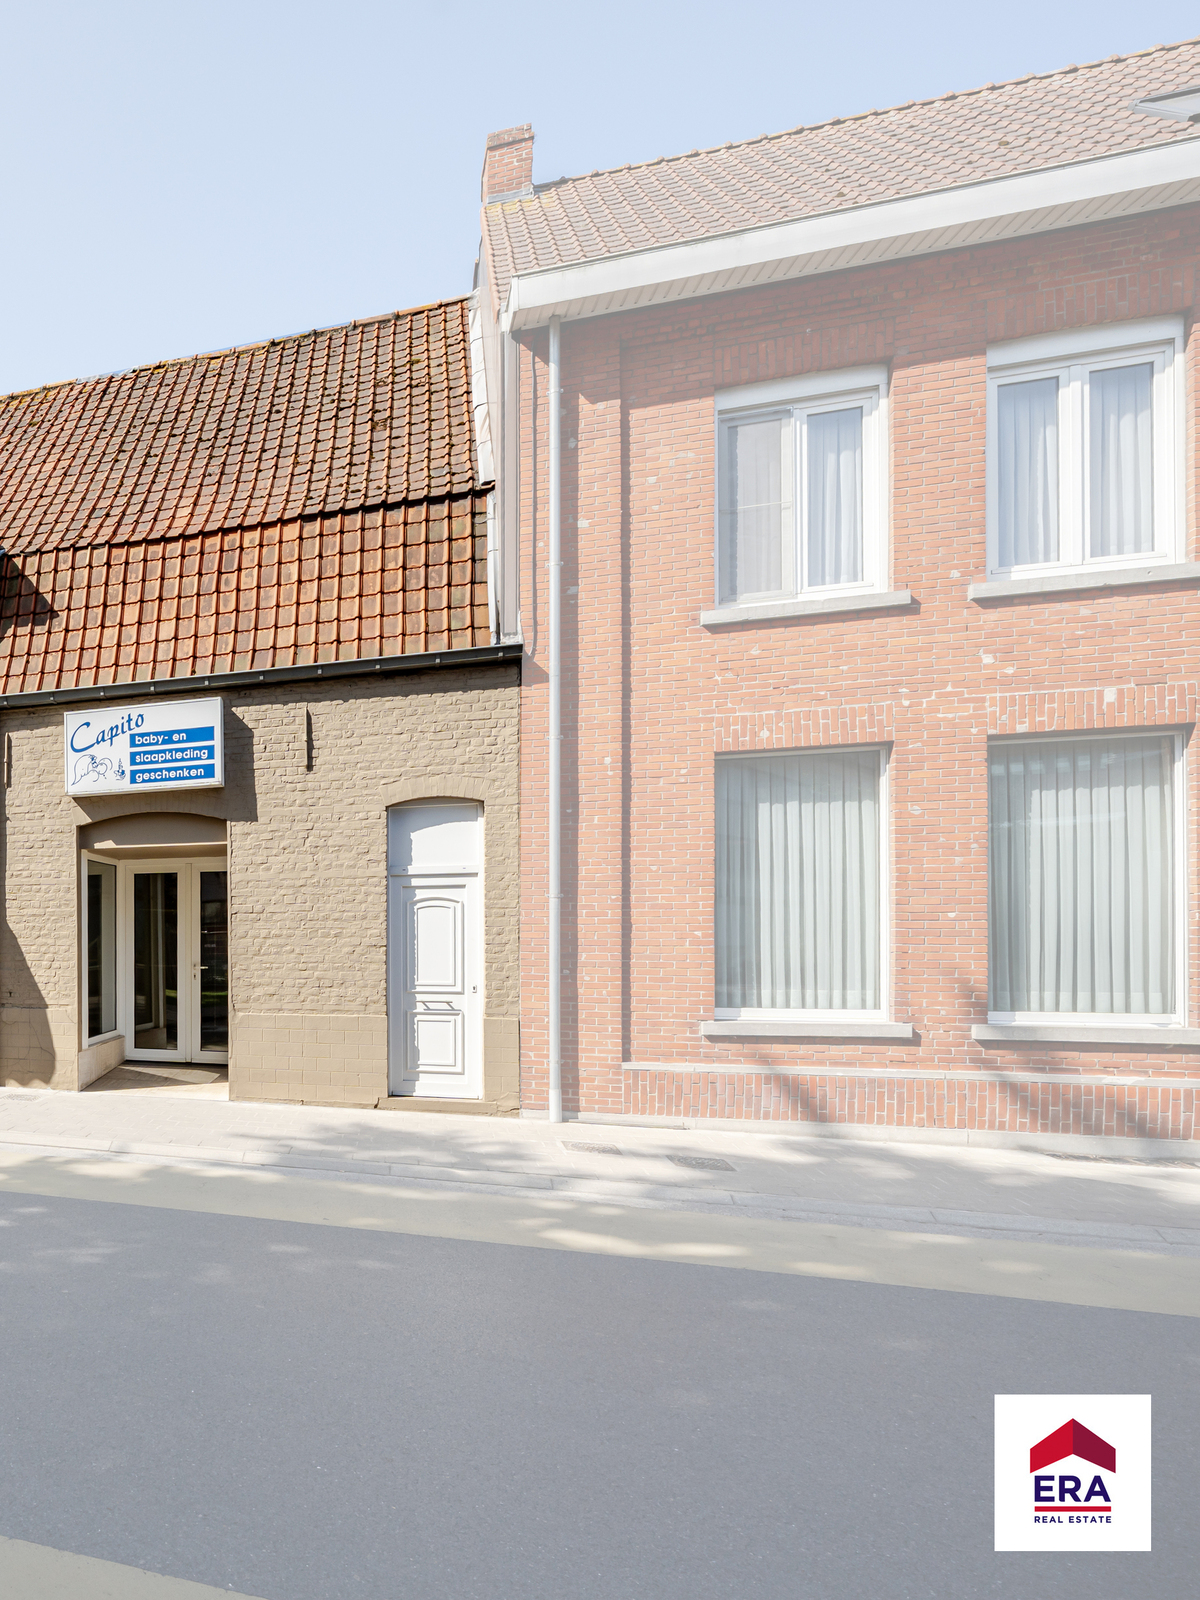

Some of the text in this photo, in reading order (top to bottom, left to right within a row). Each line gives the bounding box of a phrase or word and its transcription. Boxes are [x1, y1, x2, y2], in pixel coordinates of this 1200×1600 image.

[70, 712, 145, 753] Capito
[135, 732, 187, 745] baby- en
[135, 748, 209, 763] slaapkleding
[135, 767, 204, 782] geschenken
